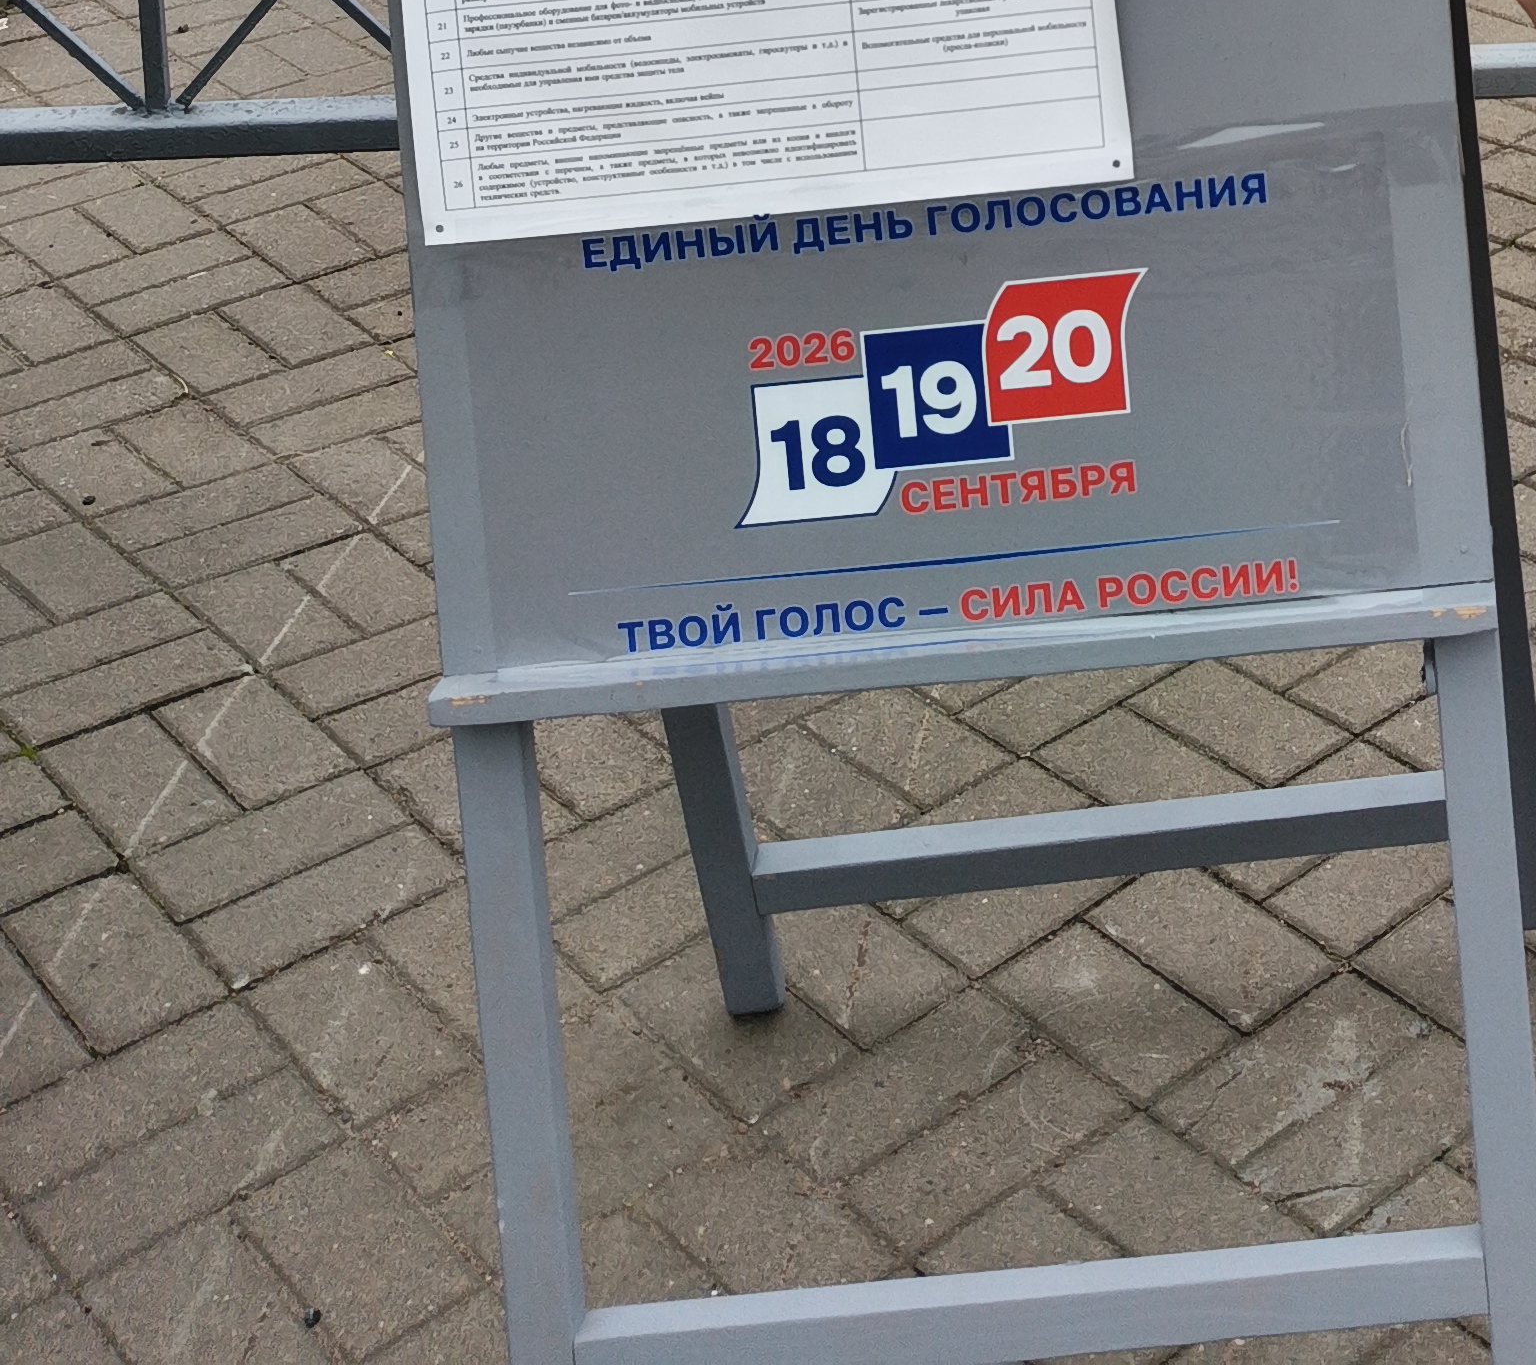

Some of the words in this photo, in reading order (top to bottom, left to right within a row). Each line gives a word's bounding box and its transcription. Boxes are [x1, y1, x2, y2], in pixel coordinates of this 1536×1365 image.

[582, 214, 779, 272] ЕДИНЫЙ
[793, 213, 914, 256] ДЕНЬ
[926, 171, 1268, 237] ГОЛОСОВАНИЯ
[749, 325, 855, 369] 2026
[770, 414, 866, 491] 18
[880, 360, 978, 439] 19
[991, 308, 1113, 391] 20
[901, 461, 1136, 514] СЕНТЯБРЯ
[617, 604, 741, 653] ТВОЙ
[755, 596, 906, 641] ГОЛОС
[960, 580, 1086, 621] СИЛА
[1096, 559, 1301, 609] РОССИИ!
